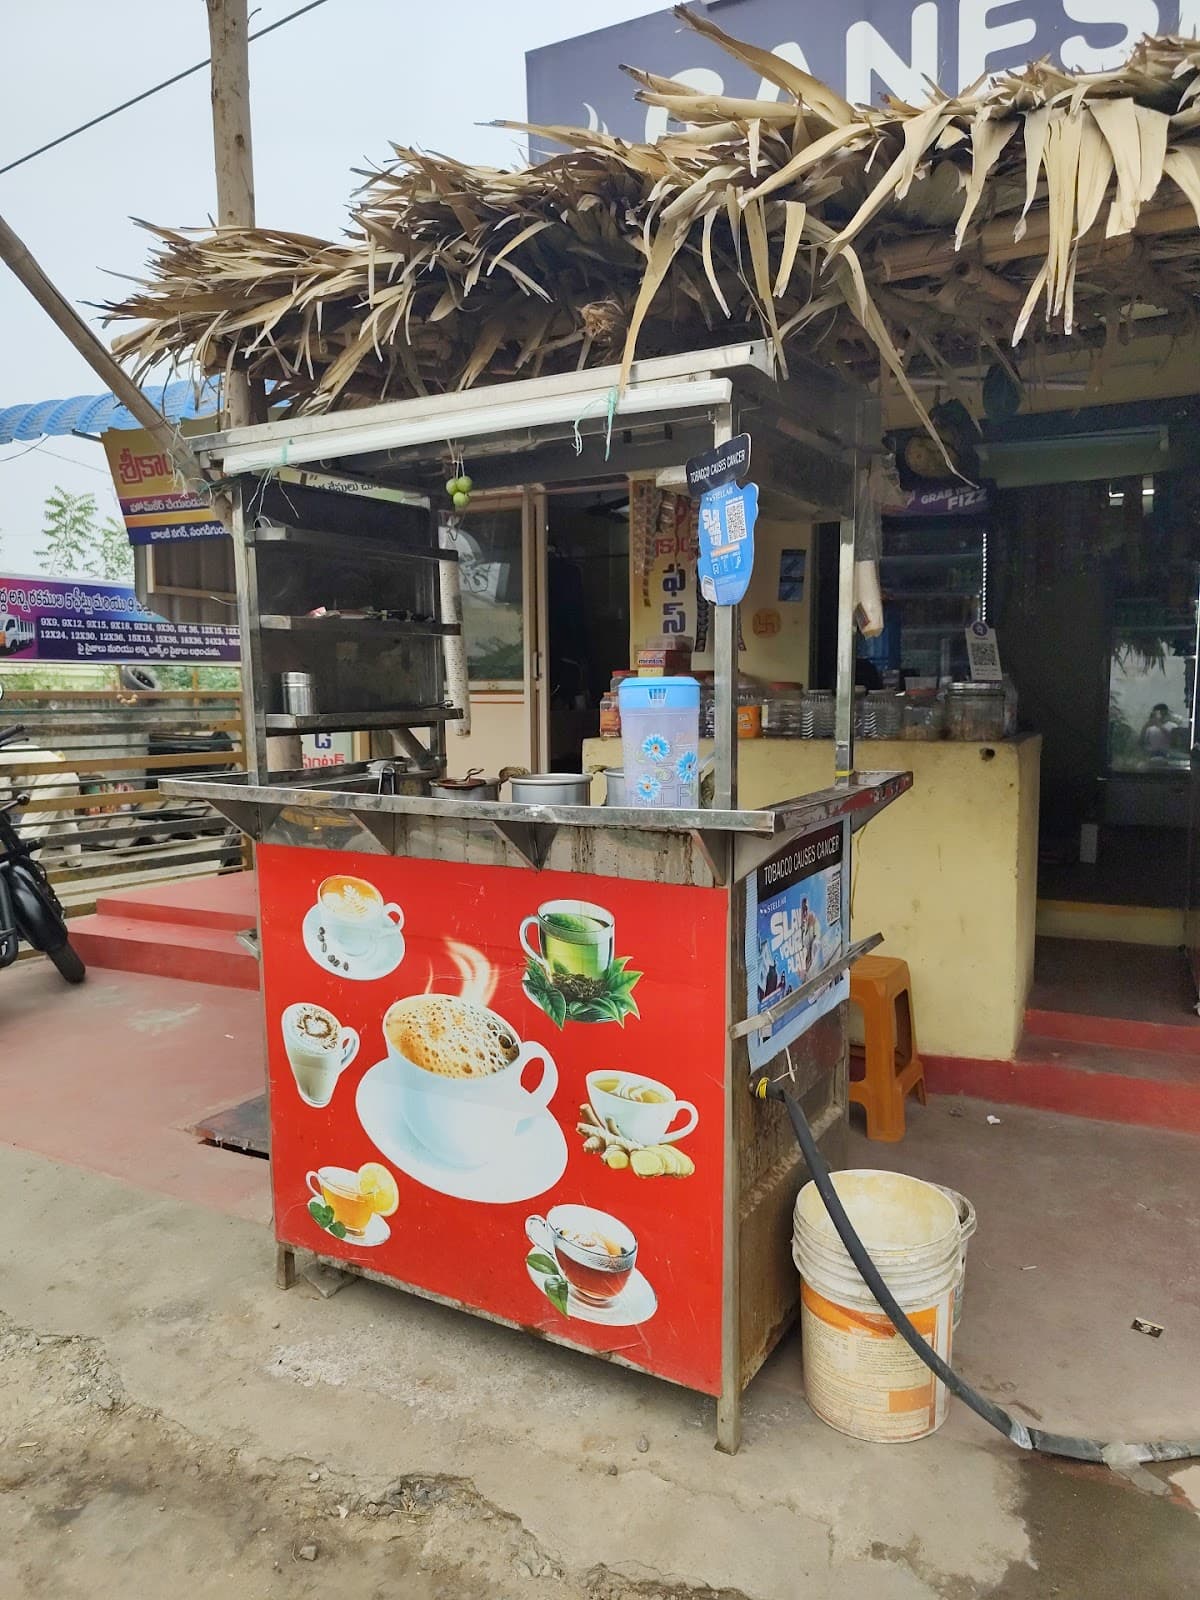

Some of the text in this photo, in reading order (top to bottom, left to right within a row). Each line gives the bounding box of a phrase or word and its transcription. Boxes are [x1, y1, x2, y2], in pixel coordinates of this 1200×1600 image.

[690, 449, 746, 484] TOBACCO CAUSES CANCER
[921, 488, 953, 505] GRAB
[947, 488, 987, 510] FIZZ
[764, 834, 840, 886] TOBACCO CAUSES CANCER
